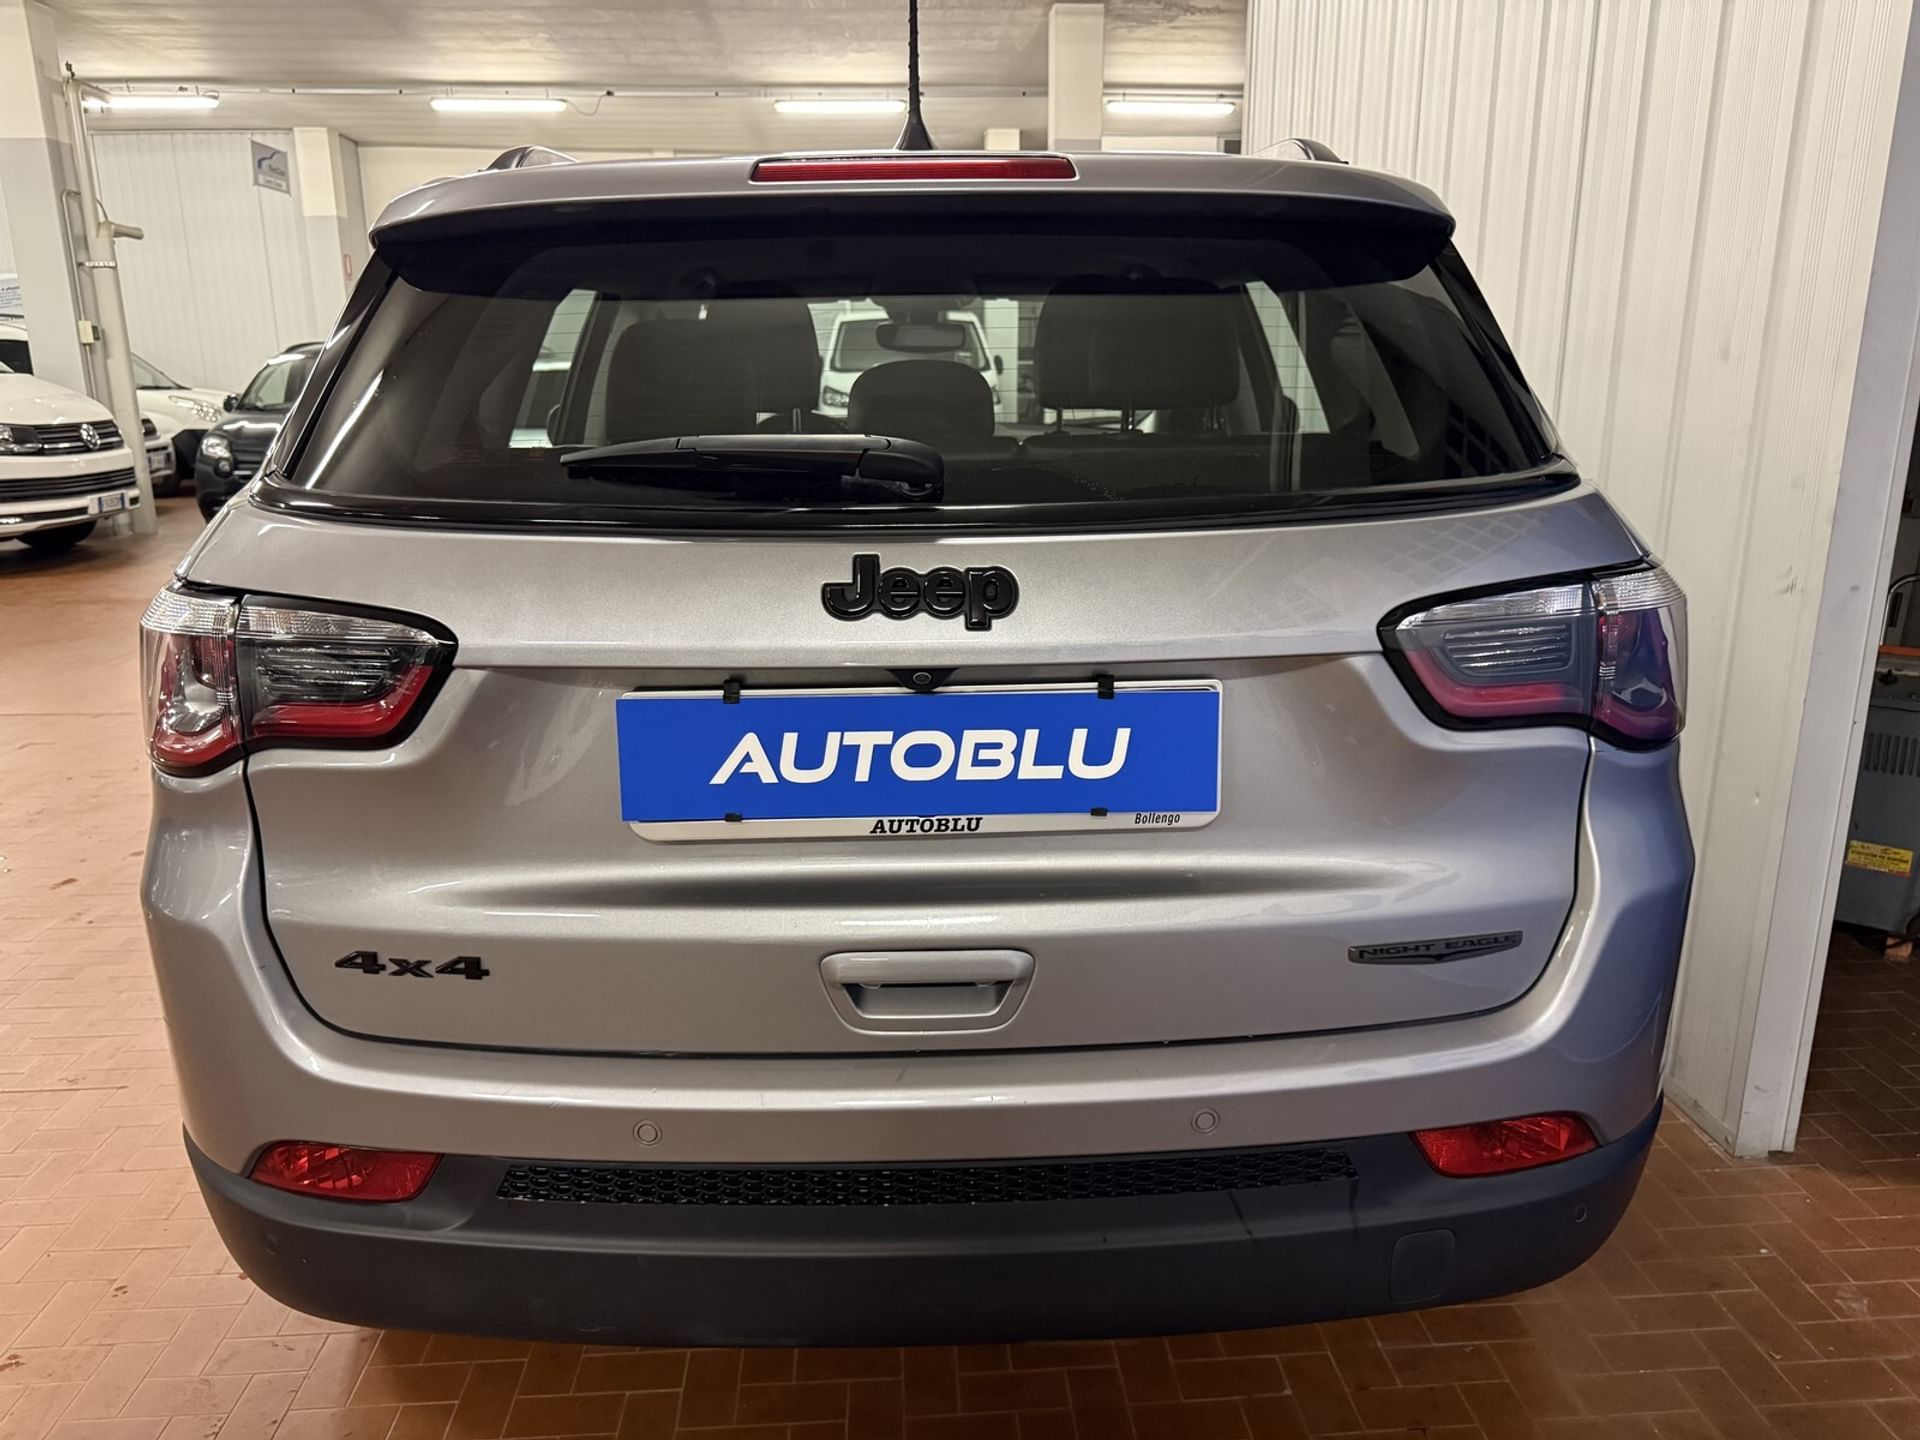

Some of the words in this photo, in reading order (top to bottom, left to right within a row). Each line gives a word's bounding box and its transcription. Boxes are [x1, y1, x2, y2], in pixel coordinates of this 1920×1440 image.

[821, 553, 1019, 631] Jeep
[709, 728, 1131, 785] AUTOBLU
[869, 816, 983, 834] AUTOBLU
[1134, 812, 1181, 826] Bollengo
[1358, 943, 1435, 960] NIGHT
[1445, 934, 1518, 950] EAGLE
[334, 950, 490, 980] 4x4
